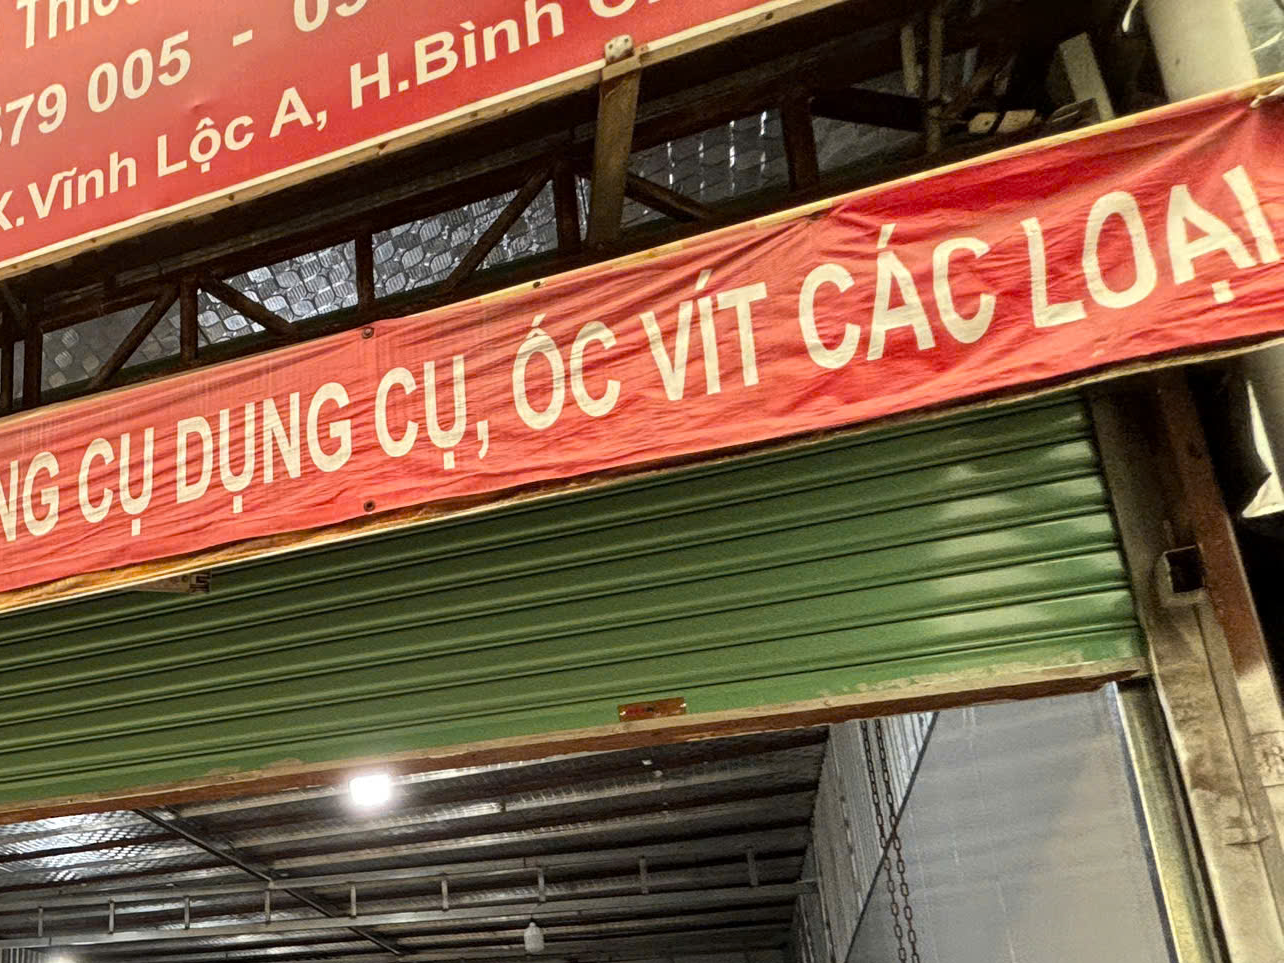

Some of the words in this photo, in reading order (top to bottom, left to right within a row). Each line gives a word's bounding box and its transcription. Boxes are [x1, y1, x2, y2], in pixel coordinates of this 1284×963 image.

[88, 31, 191, 112] 005
[158, 116, 253, 176] Lộc
[270, 88, 326, 137] A,
[351, 0, 563, 108] H.Bình
[79, 428, 154, 537] CỤ
[176, 383, 352, 514] DỤNG
[375, 355, 488, 469] CỤ,
[512, 313, 620, 430] ỐC
[639, 272, 767, 400] VÍT
[799, 223, 997, 368] CÁC
[1020, 165, 1284, 327] LOẠI
